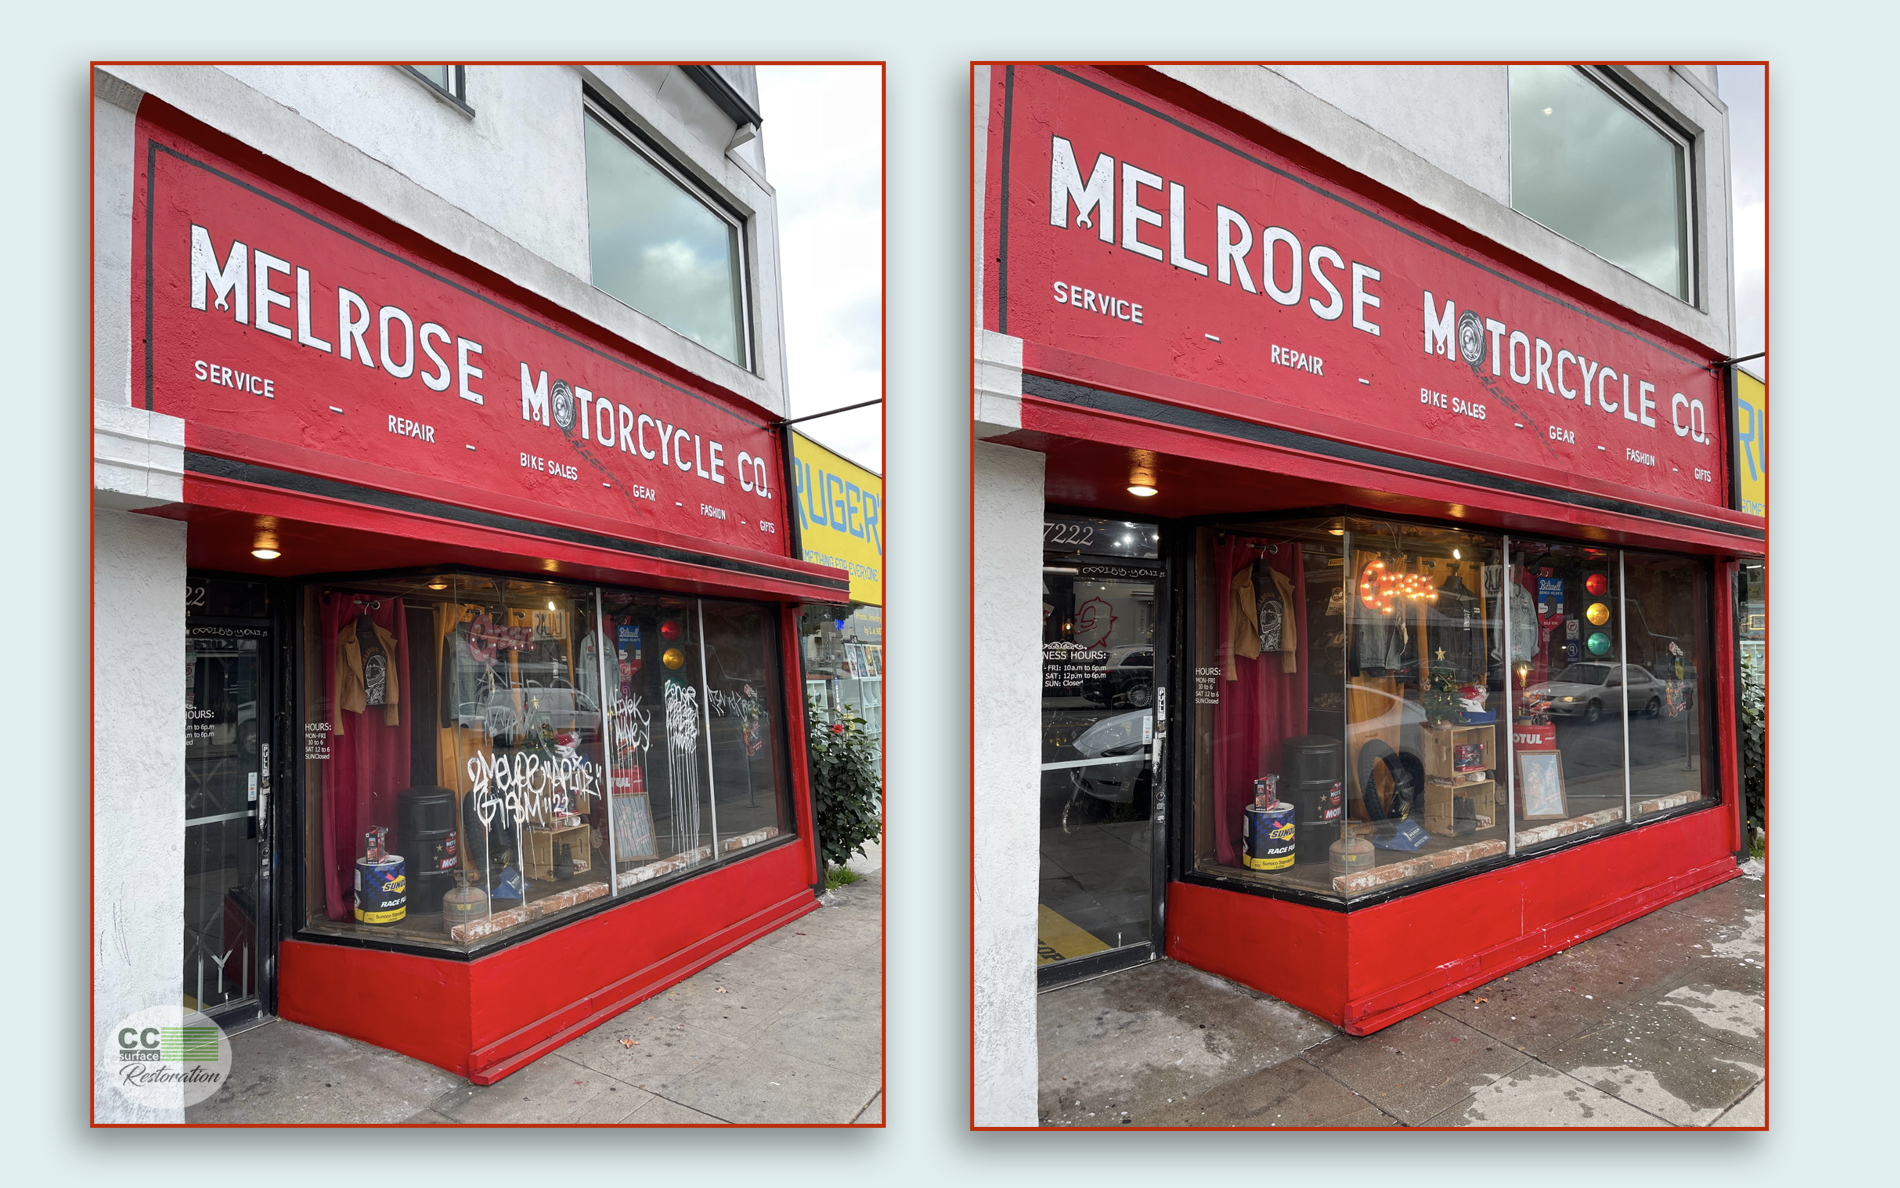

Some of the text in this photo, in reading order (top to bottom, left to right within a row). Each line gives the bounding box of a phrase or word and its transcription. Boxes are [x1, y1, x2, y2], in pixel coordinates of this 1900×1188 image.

[1049, 134, 1711, 446] MELROSE MOTORCYCLE CO.
[189, 222, 773, 500] MELROSE MOTORCYCLE CO.
[1053, 281, 1712, 483] SERVICE REPAIR BIKE SALES GEAR FASHION GIFTS
[194, 360, 775, 535] SERVICE REPAIR BIKE SALES GEAR FASHION GIFTS
[849, 561, 879, 582] EVERYONE
[1361, 559, 1437, 616] Open
[466, 614, 537, 667] Open
[1071, 650, 1106, 660] HOURS:
[1091, 664, 1107, 672] 6p.m
[1195, 667, 1221, 676] HOURS:
[1091, 672, 1107, 680] 6p.m
[305, 722, 332, 731] HOURS:
[201, 731, 215, 739] 6p.m
[1267, 845, 1288, 855] RACE
[381, 898, 400, 908] RACE
